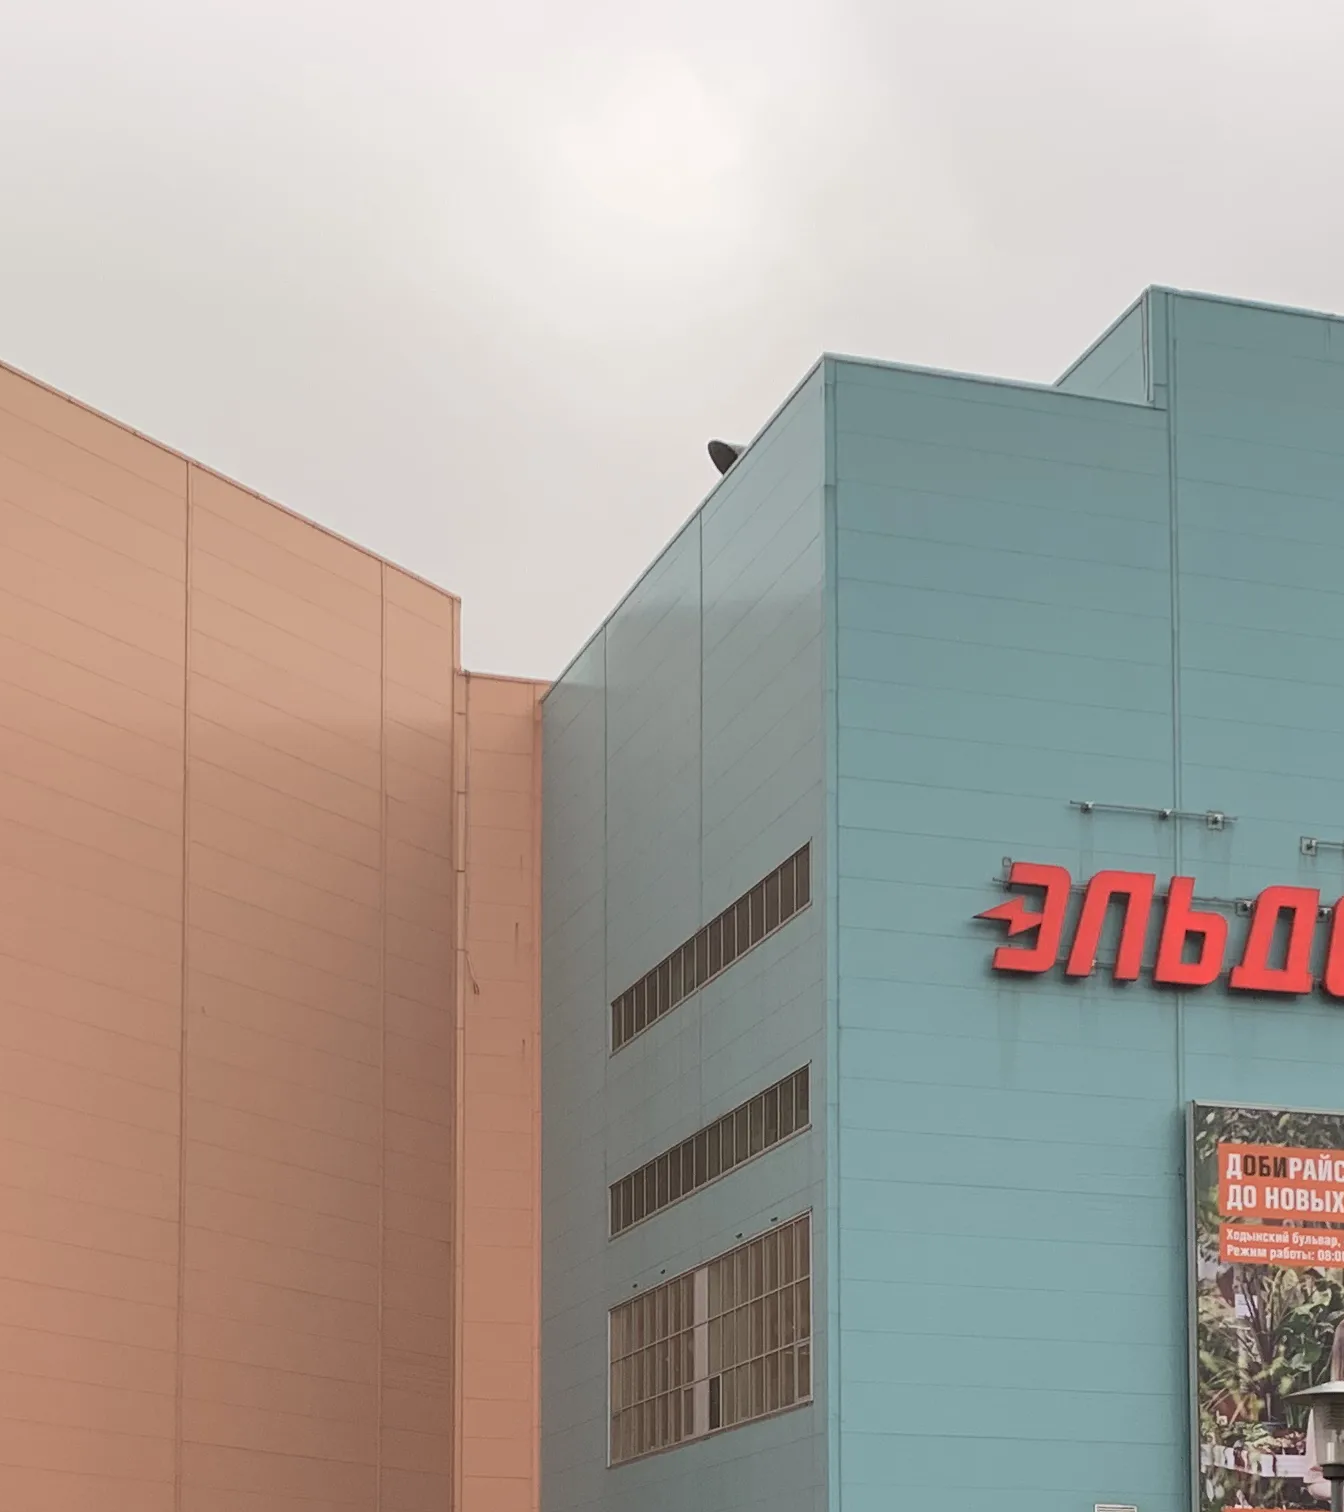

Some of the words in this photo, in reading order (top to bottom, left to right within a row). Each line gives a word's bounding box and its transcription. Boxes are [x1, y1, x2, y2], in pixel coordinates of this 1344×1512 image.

[1227, 1184, 1257, 1211] ДО
[1265, 1187, 1344, 1213] НОВЫХ
[1226, 1228, 1289, 1243] Ходынский
[1227, 1244, 1267, 1257] Режим
[1269, 1246, 1315, 1261] работы:
